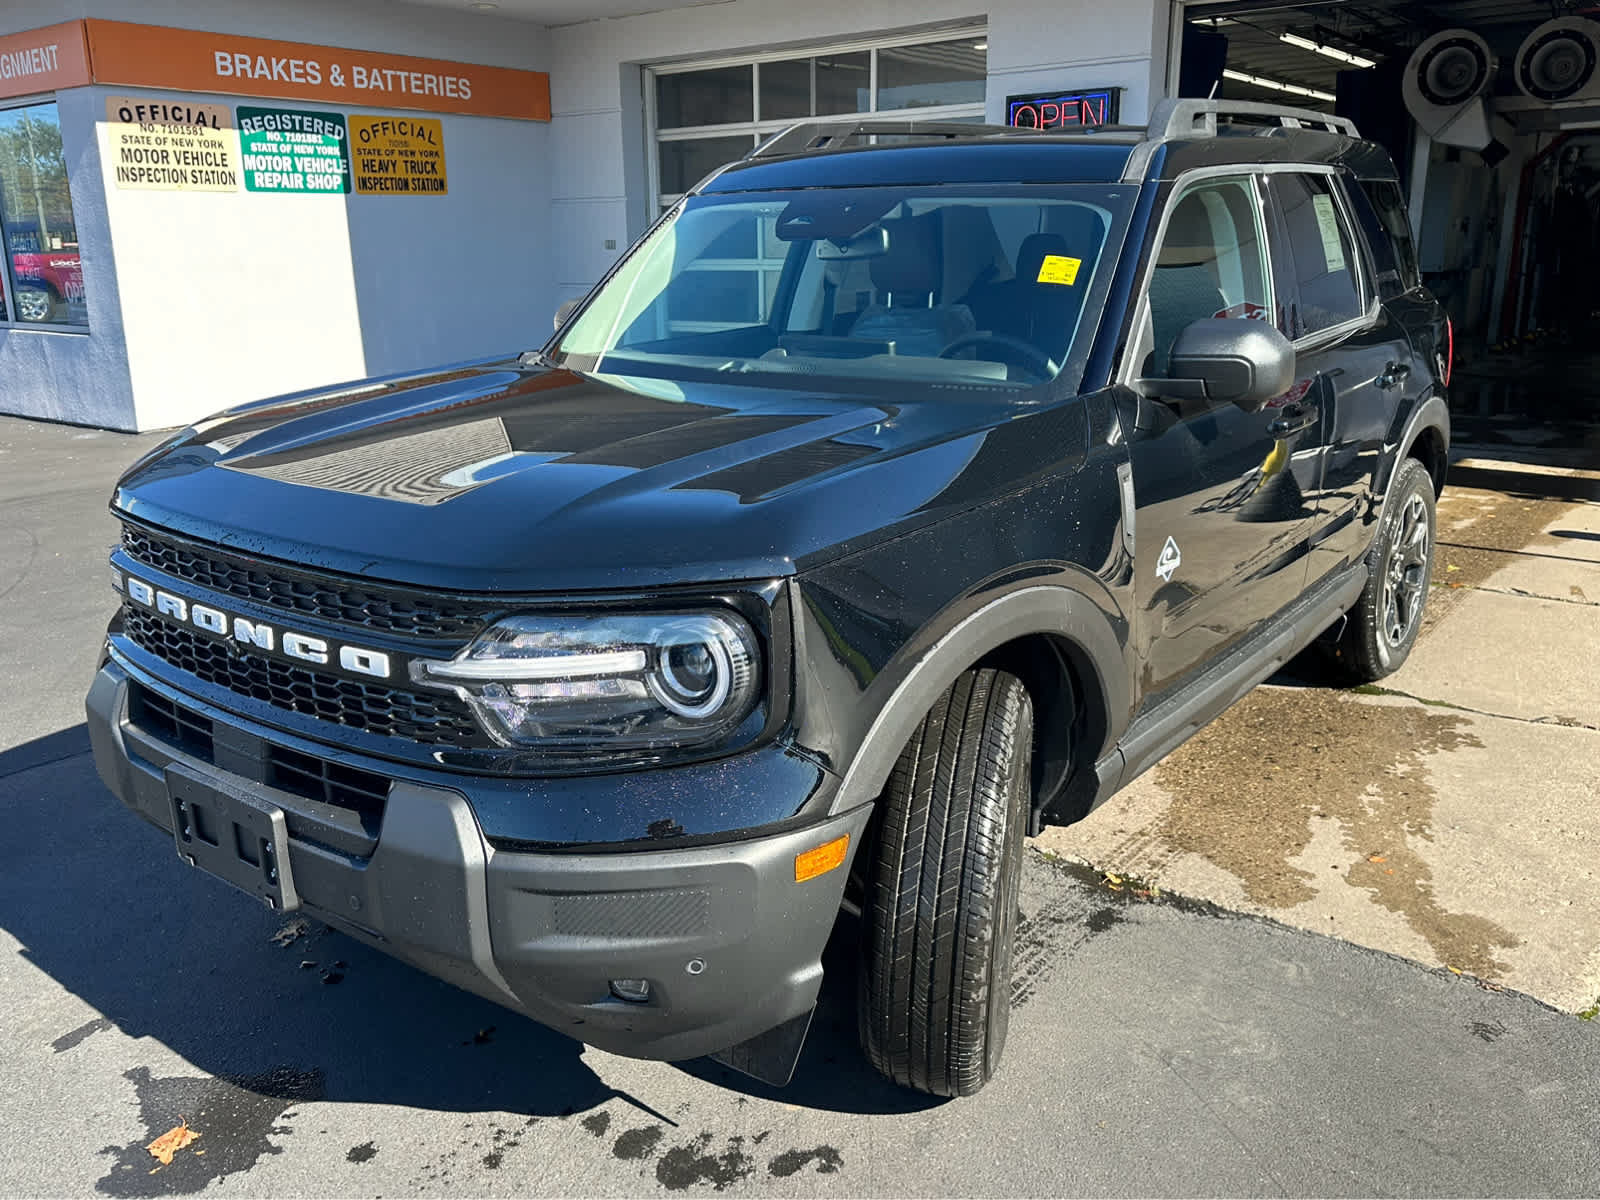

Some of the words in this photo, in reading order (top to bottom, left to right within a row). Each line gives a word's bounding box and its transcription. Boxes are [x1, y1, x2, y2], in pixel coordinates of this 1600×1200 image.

[0, 45, 57, 80] GNMENT
[214, 51, 322, 85] BRAKES
[330, 64, 345, 87] &
[352, 66, 472, 100] BATTERIES
[118, 105, 221, 130] OFFICIAL
[1014, 99, 1104, 131] OPEN
[139, 123, 158, 133] NO.
[161, 124, 204, 136] 7101581
[240, 114, 345, 140] REGISTERED
[266, 131, 283, 142] NO.
[359, 120, 437, 146] OFFICIAL
[121, 134, 152, 145] STATE
[155, 137, 168, 146] OF
[171, 138, 194, 148] NEW
[197, 139, 224, 149] YORK
[250, 142, 278, 153] STATE
[279, 143, 292, 153] OF
[293, 144, 314, 155] NEW
[315, 145, 340, 156] YORK
[120, 147, 170, 165] MOTOR
[173, 150, 228, 167] VEHICLE
[356, 147, 382, 156] STATE
[384, 148, 395, 156] OF
[398, 149, 416, 158] NEW
[418, 149, 440, 158] YORK
[243, 154, 292, 171] MOTOR
[294, 156, 348, 174] VEHICLE
[361, 158, 397, 174] HEAVY
[403, 160, 438, 175] TRUCK
[116, 166, 188, 184] INSPECTION
[191, 169, 236, 185] STATION
[253, 172, 304, 189] REPAIR
[306, 173, 342, 190] SHOP
[357, 176, 410, 191] INSPECTION
[411, 177, 445, 192] STATION
[128, 577, 390, 678] BRONCO
